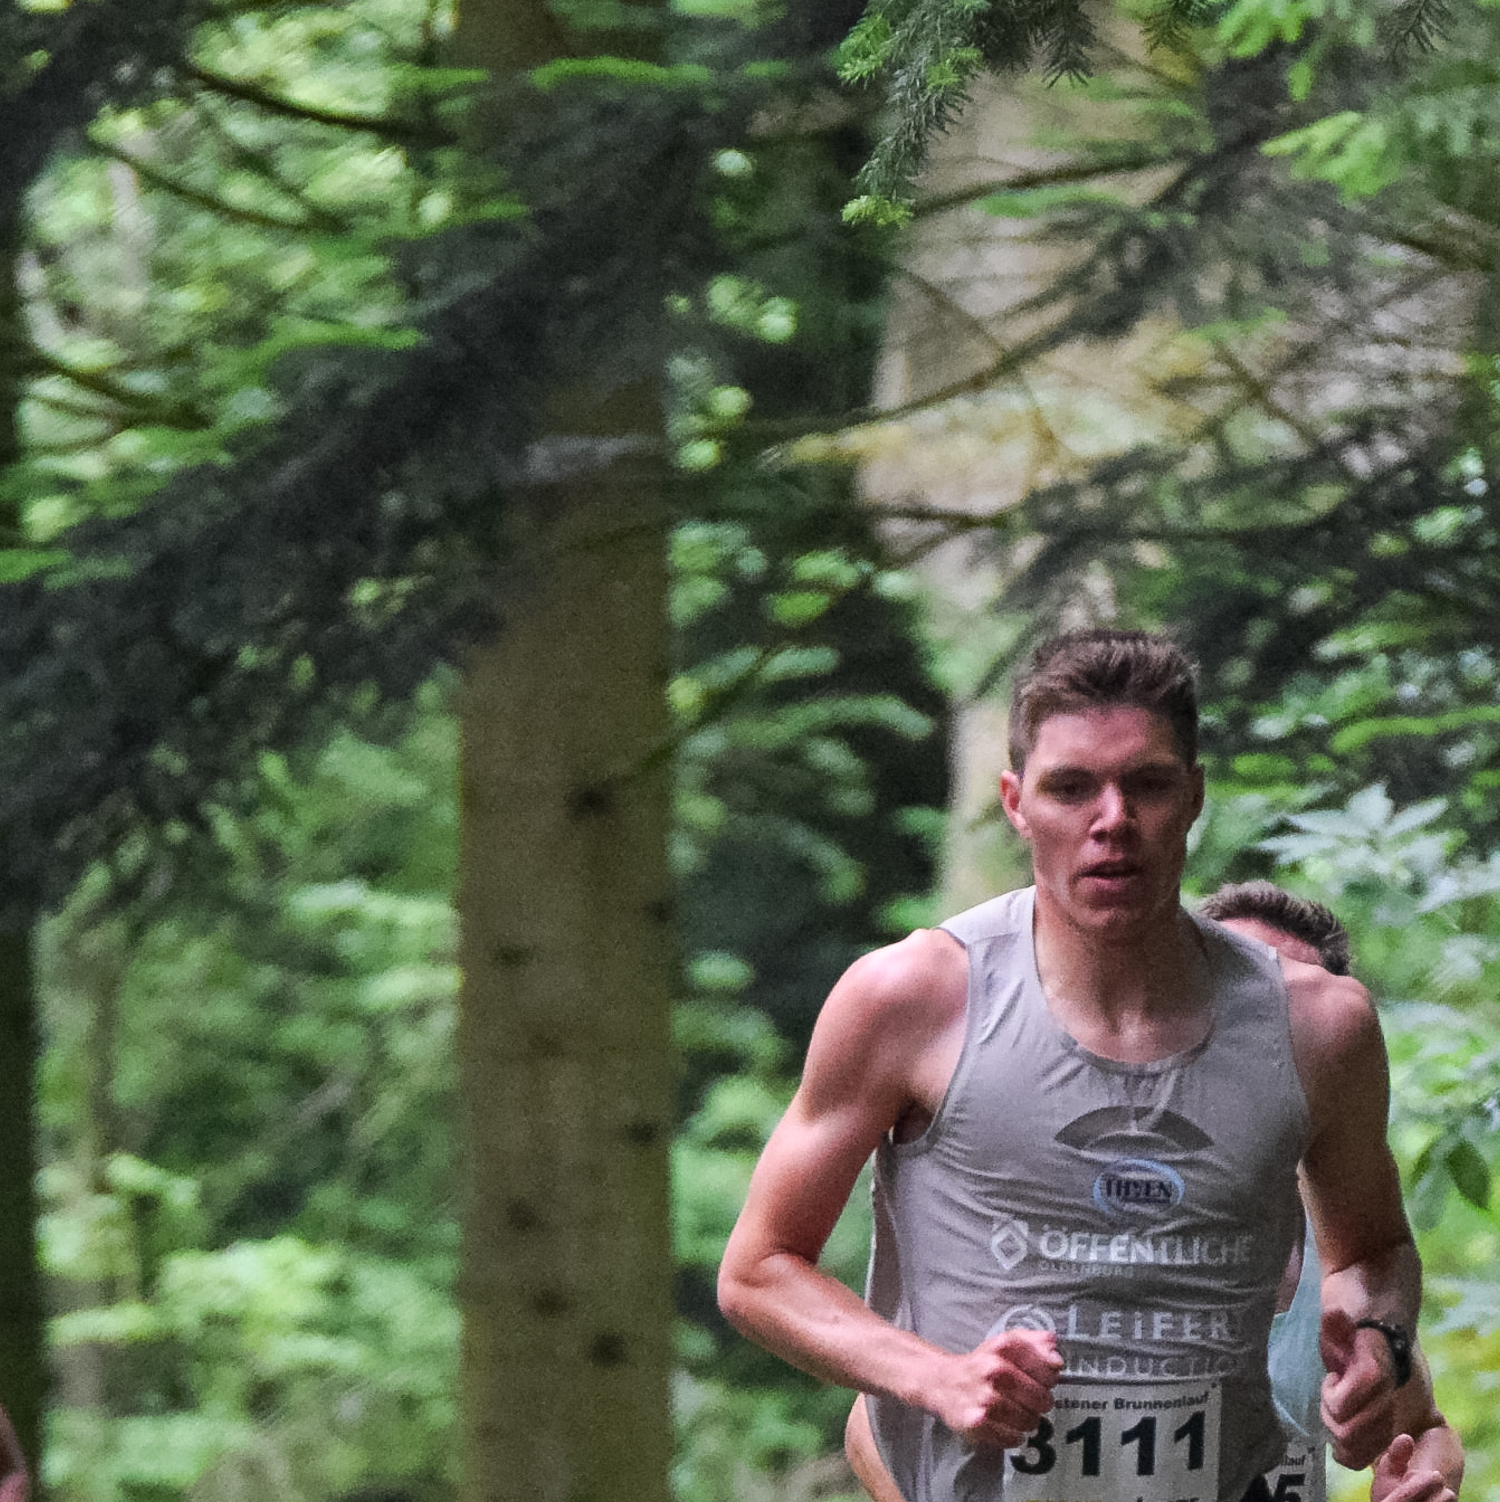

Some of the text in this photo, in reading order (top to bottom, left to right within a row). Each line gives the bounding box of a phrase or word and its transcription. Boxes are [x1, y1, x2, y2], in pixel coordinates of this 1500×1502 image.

[1105, 1178, 1172, 1199] THYEN
[1114, 1391, 1209, 1411] Brunnenlauf
[1011, 1411, 1205, 1477] 3111
